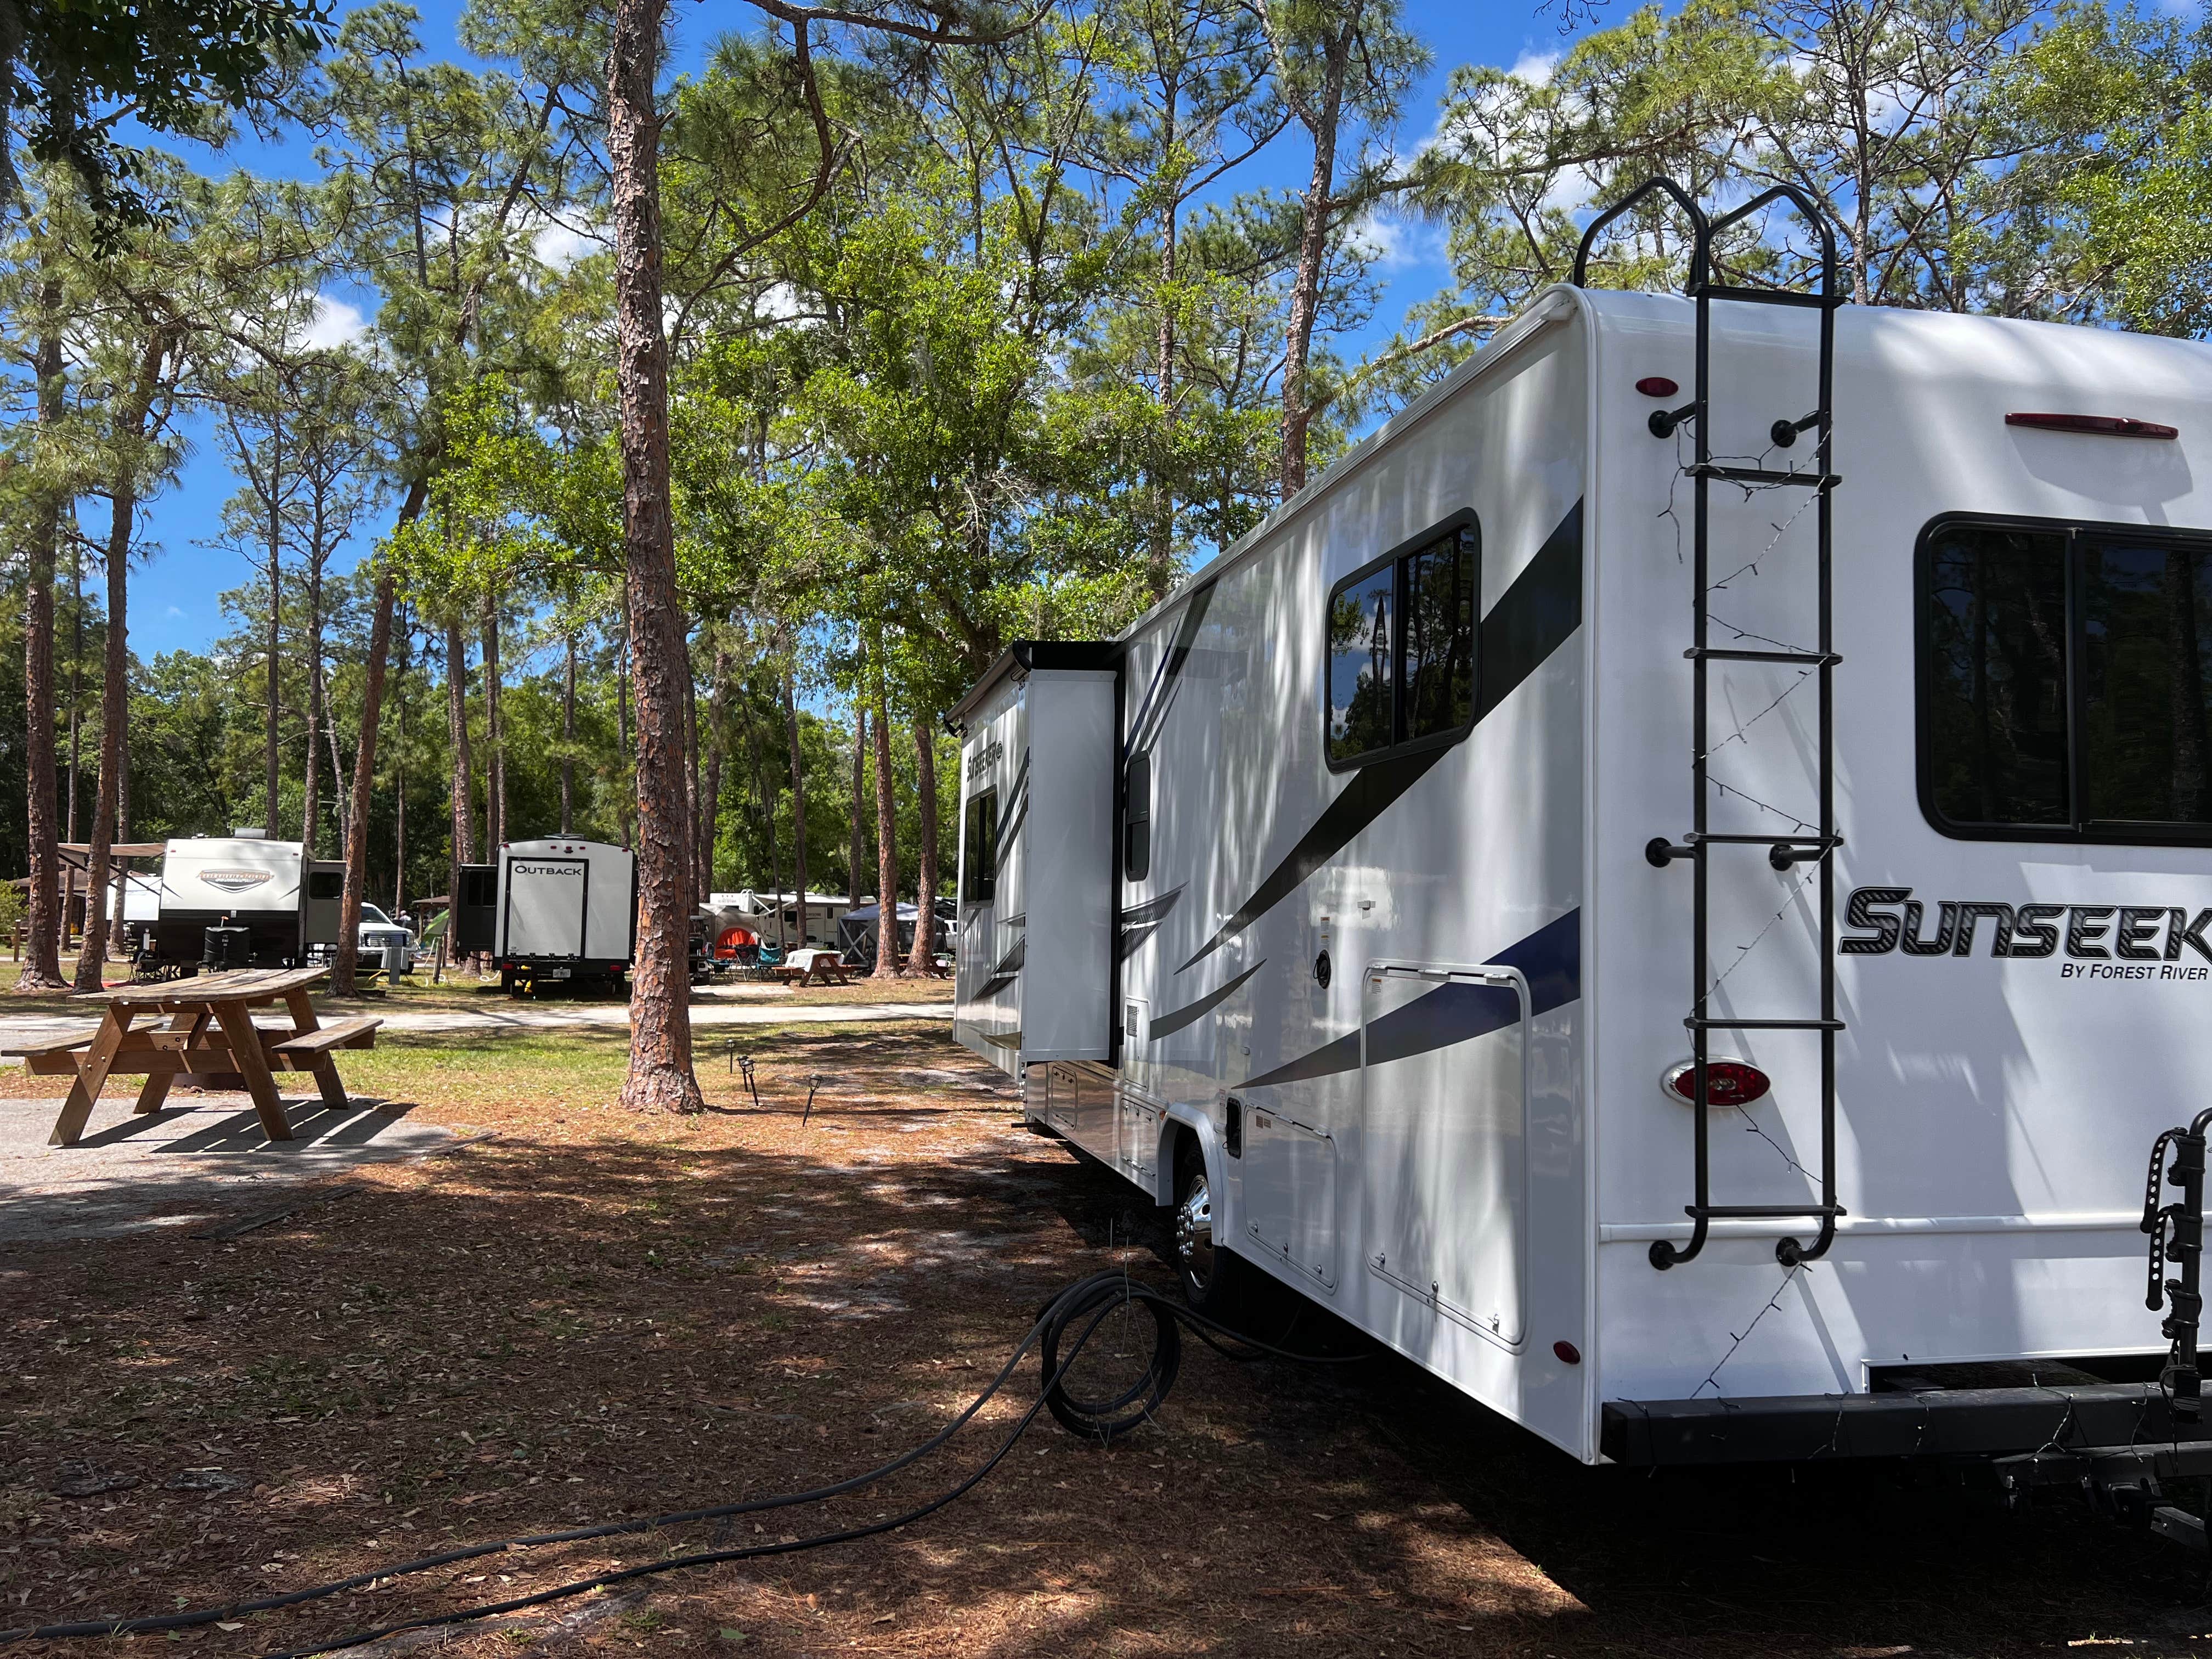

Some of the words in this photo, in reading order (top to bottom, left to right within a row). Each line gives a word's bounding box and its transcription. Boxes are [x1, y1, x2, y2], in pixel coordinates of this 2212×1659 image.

[515, 865, 582, 876] OUTBACK
[2061, 963, 2085, 978] BY
[2090, 963, 2156, 979] FOREST
[2160, 965, 2209, 980] RIVER
